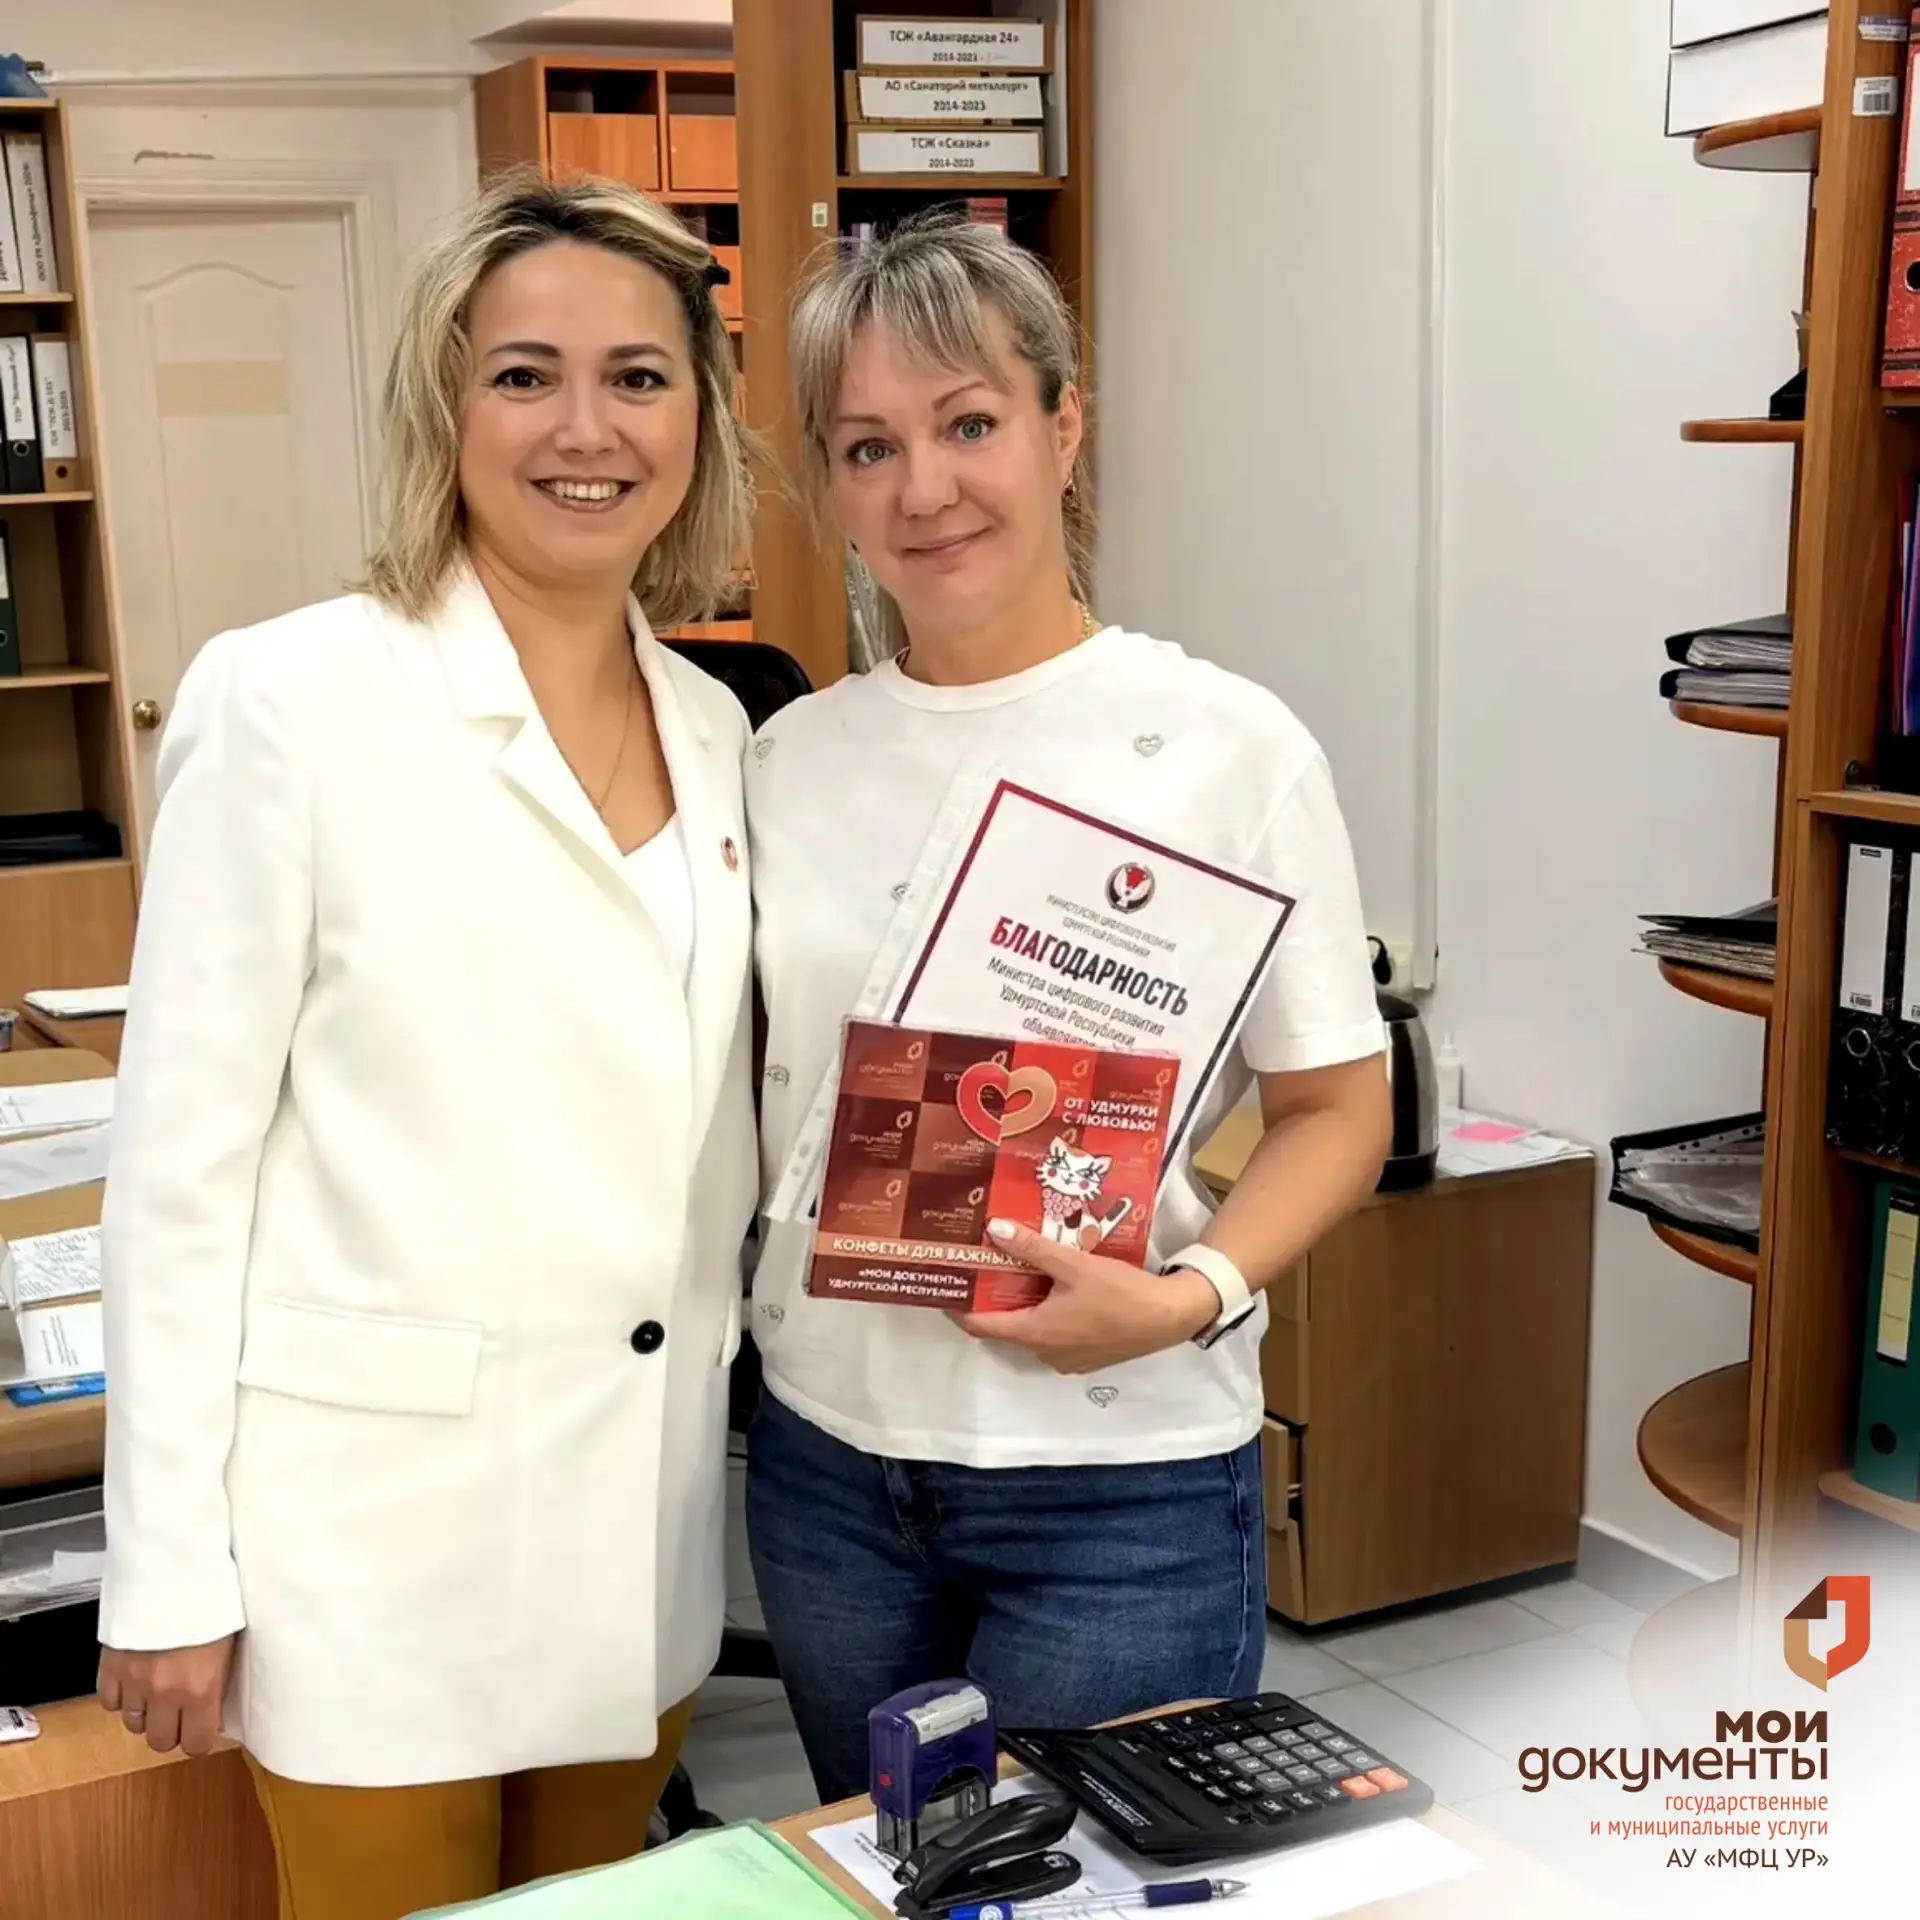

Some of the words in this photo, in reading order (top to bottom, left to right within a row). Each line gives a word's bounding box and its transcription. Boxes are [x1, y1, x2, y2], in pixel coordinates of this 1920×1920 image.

[889, 30, 914, 43] ТСЖ
[885, 80, 901, 91] АО
[904, 80, 966, 93] «Санаторий
[911, 138, 935, 148] ТСЖ
[938, 138, 990, 148] «Сказка»
[990, 915, 1188, 1016] БЛАГОДАРНОСТЬ
[987, 956, 1047, 991] Министра
[1047, 982, 1111, 1016] цифрового
[1109, 1002, 1165, 1037] развития
[999, 984, 1067, 1021] Удмуртской
[1067, 1009, 1136, 1047] Республики
[1064, 1098, 1083, 1109] ОТ
[1091, 1099, 1159, 1118] УДМУРКИ
[1062, 1112, 1071, 1123] С
[1076, 1114, 1156, 1132] ЛЮБОВЬЮ!
[833, 1238, 908, 1256] КОНФЕТЫ
[911, 1245, 943, 1260] ДЛЯ
[859, 1268, 891, 1279] «МОИ
[893, 1269, 969, 1286] ДОКУМЕНТЫ»
[828, 1277, 898, 1293] УДМУРТСКОЙ
[900, 1285, 967, 1299] РЕСПУБЛИКИ
